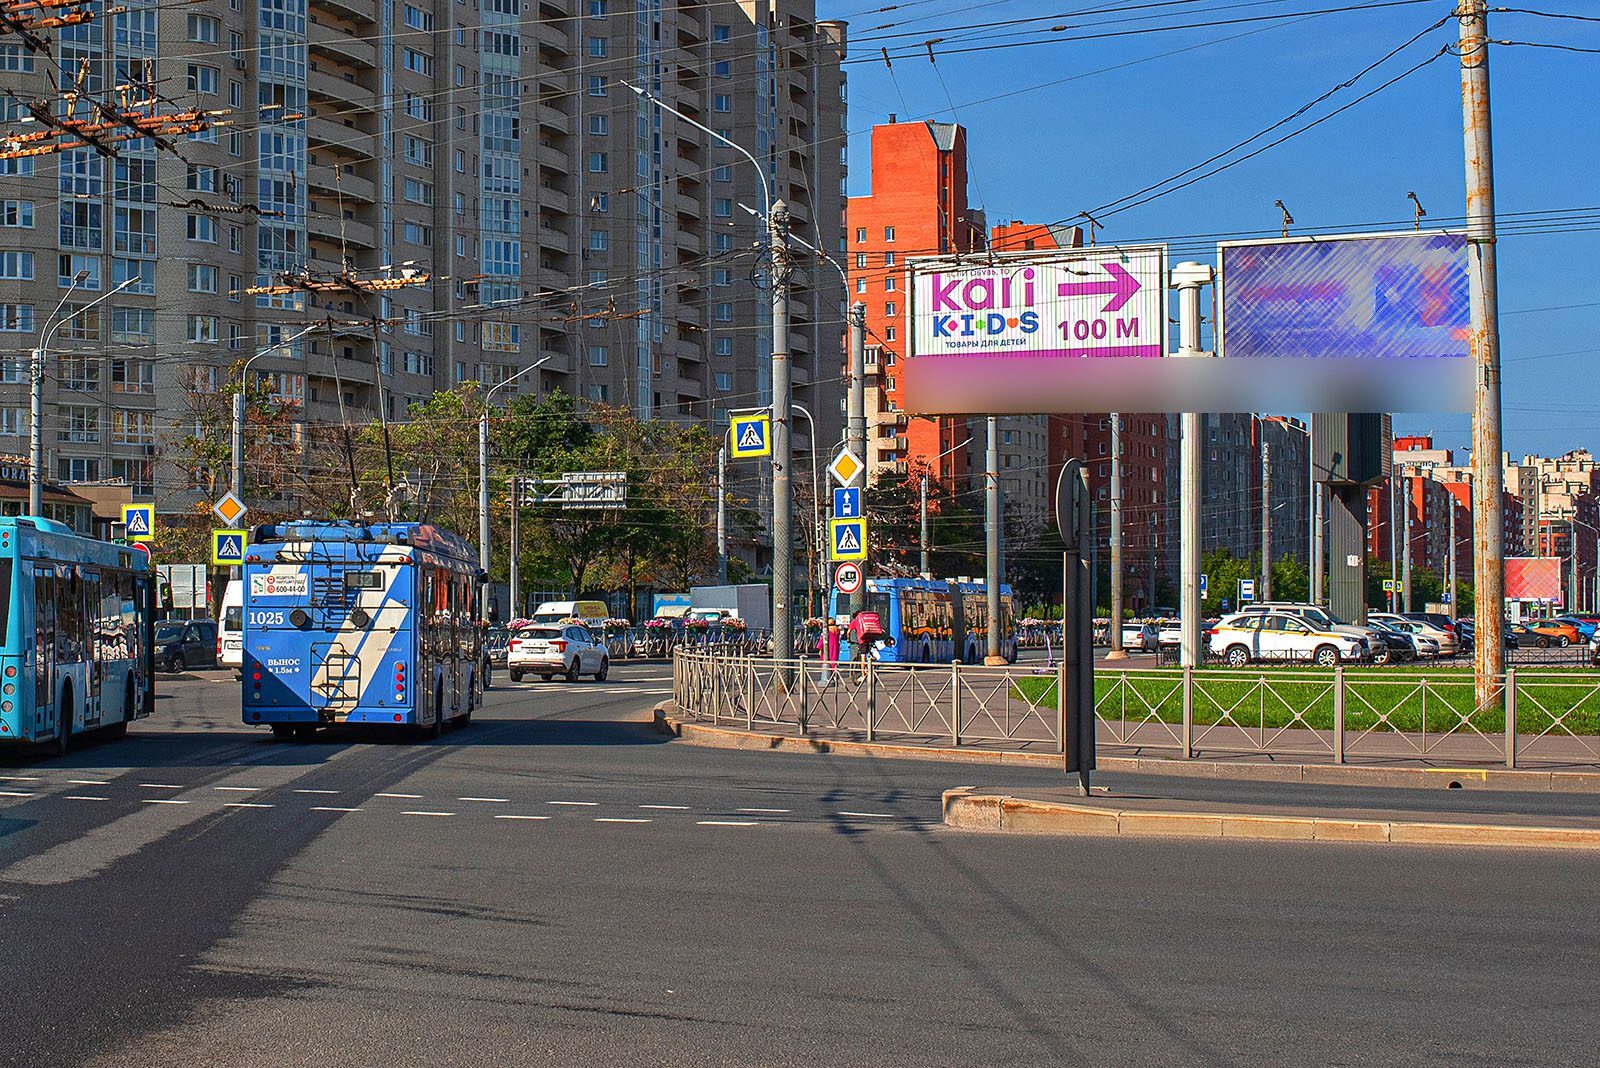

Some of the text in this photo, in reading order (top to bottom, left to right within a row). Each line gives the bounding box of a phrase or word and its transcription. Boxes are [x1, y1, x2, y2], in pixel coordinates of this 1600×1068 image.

[932, 267, 1035, 312] kari
[1057, 317, 1139, 341] 100 М
[945, 338, 1027, 349] ТОВАРЫ ДЛЯ ДЕТЕЙ
[276, 585, 306, 593] 600-44-00
[249, 611, 284, 625] 1025
[267, 658, 301, 666] ВЫНОС
